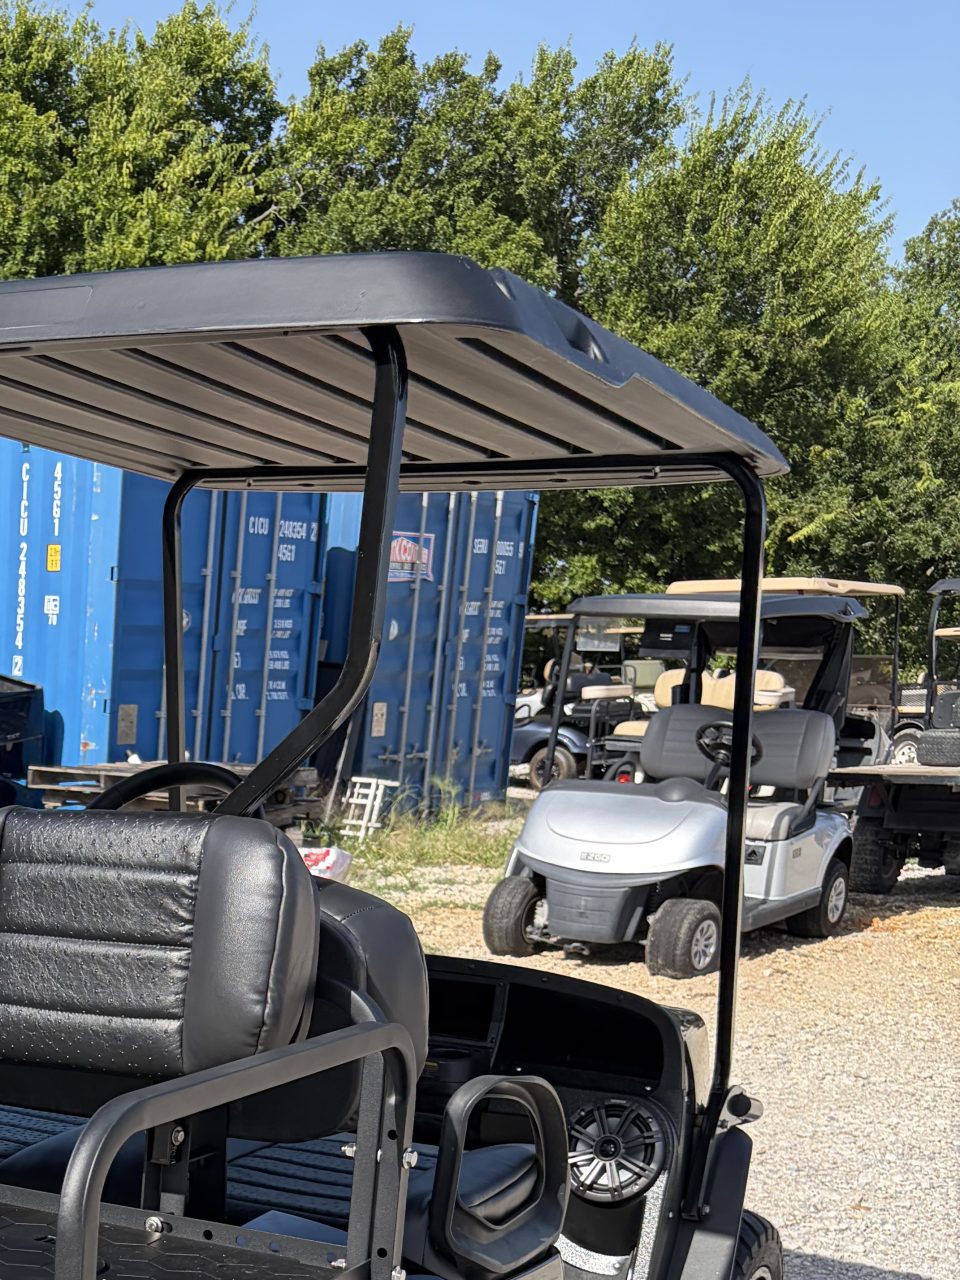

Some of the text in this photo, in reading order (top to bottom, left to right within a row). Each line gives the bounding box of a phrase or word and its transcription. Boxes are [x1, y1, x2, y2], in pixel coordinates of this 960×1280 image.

[12, 462, 30, 676] CICU 248354 2
[248, 516, 270, 535] CICU
[279, 520, 307, 539] 248354
